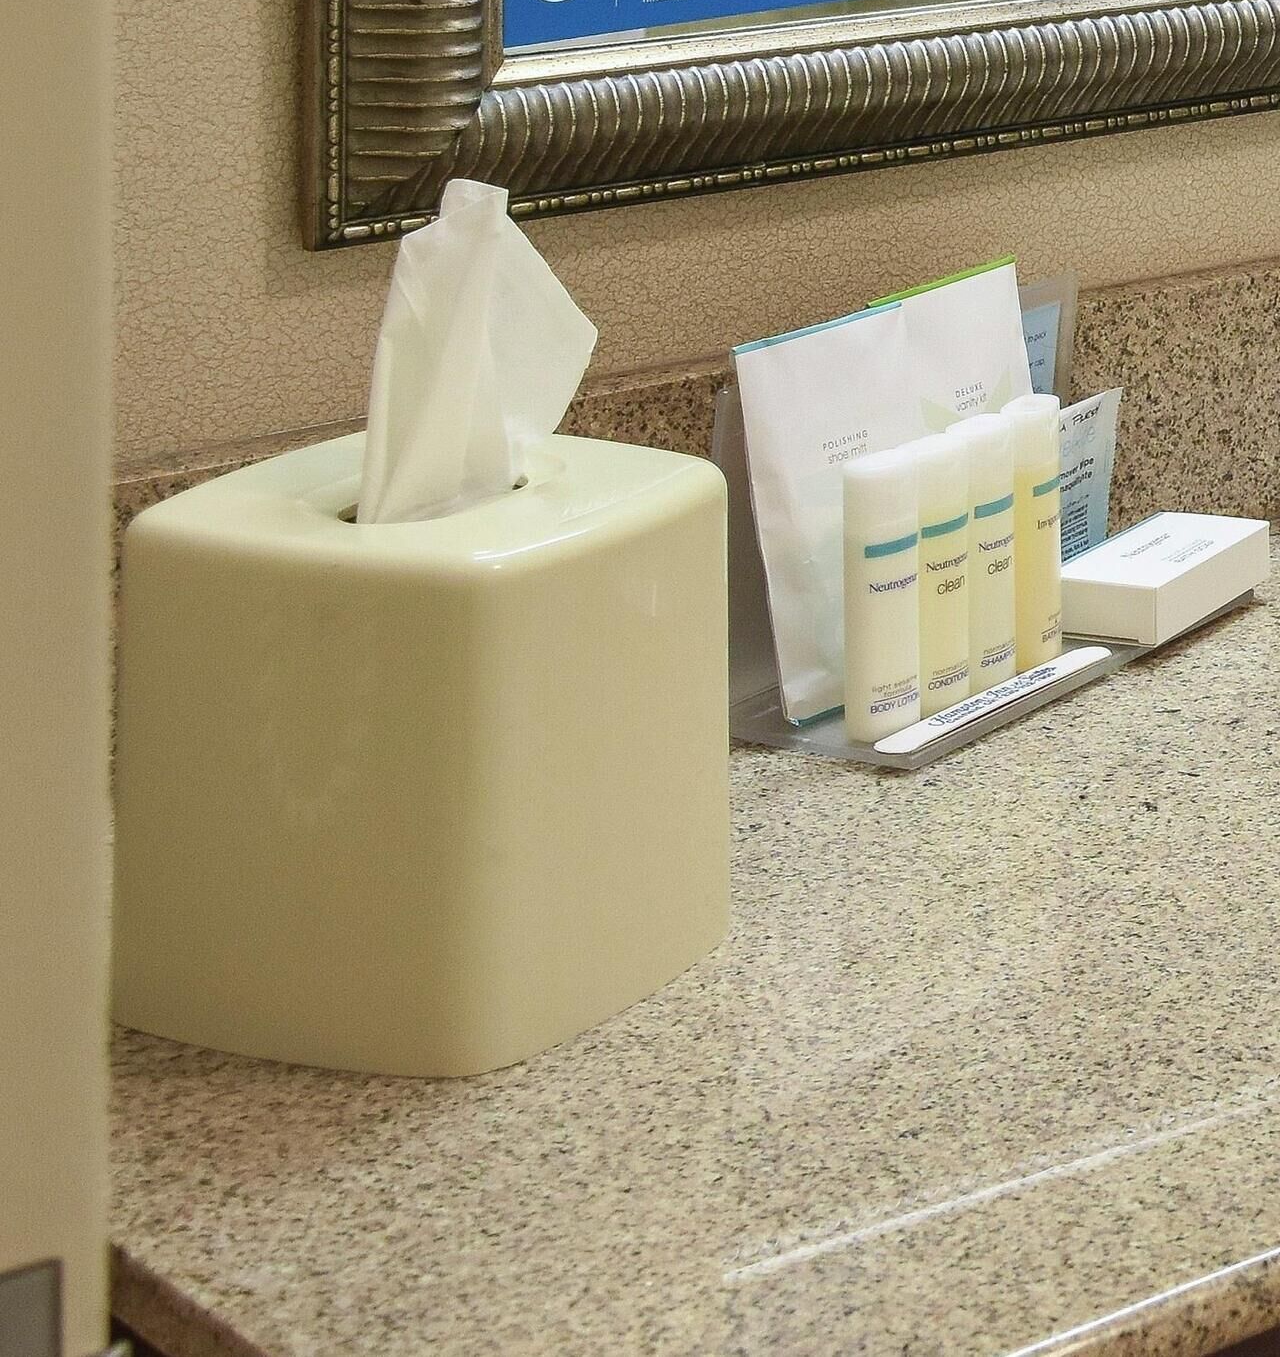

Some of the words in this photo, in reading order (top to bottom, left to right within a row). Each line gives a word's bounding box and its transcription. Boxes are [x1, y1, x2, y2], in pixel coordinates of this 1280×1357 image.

[955, 382, 984, 398] DELUXE
[956, 397, 979, 412] vanity
[822, 429, 868, 451] POLISHING
[828, 448, 849, 464] shoe
[988, 555, 1013, 574] clean
[937, 575, 965, 594] clean
[870, 701, 896, 713] BODY
